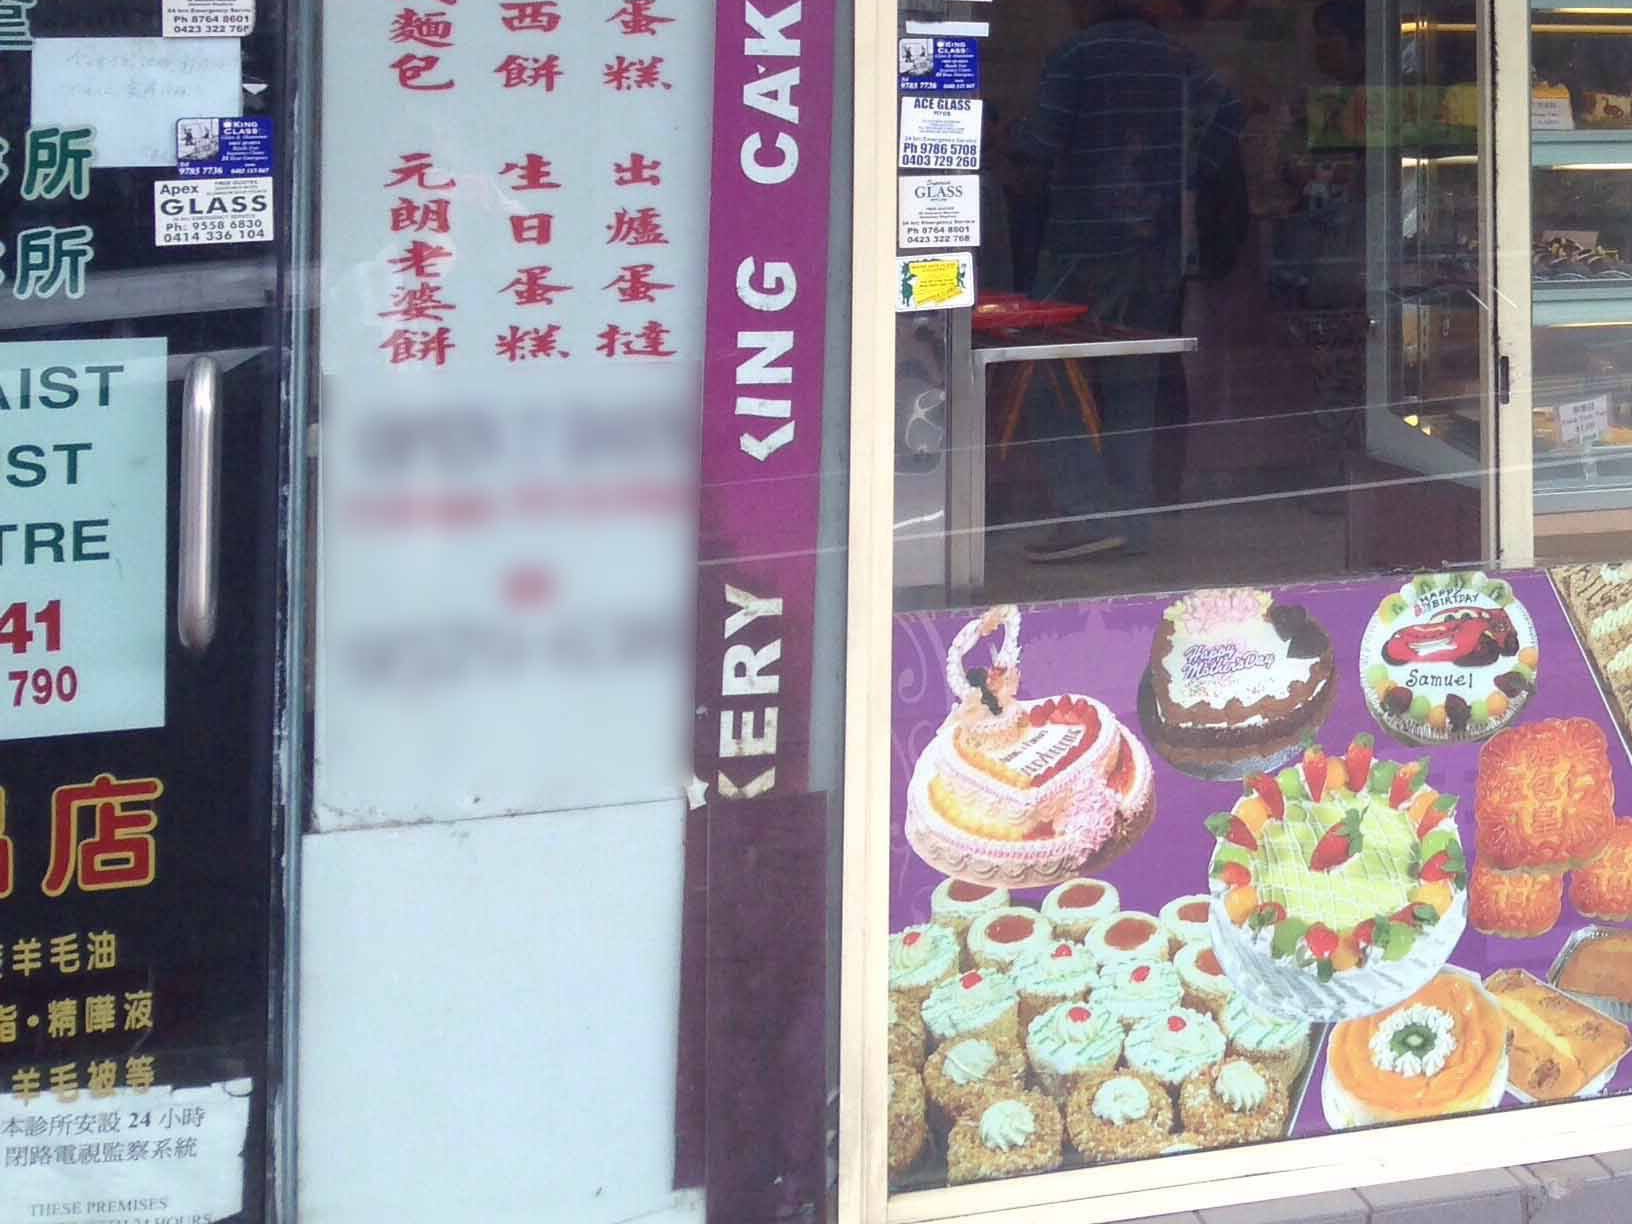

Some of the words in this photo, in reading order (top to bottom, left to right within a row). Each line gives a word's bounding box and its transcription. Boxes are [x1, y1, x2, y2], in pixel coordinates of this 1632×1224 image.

[174, 25, 202, 33] 0423
[914, 98, 934, 110] ACE
[937, 99, 971, 111] GLASS
[904, 143, 917, 153] Ph
[920, 143, 948, 155] 9786
[951, 144, 977, 156] 5708
[0, 128, 97, 201] 所
[902, 154, 931, 167] 0403
[934, 156, 954, 168] 729
[956, 157, 977, 168] 260
[160, 184, 199, 196] Apex
[914, 185, 963, 199] GLASS
[160, 195, 267, 215] GLASS
[193, 221, 225, 231] 9558
[230, 219, 263, 229] 6830
[164, 231, 200, 244] 0414
[206, 230, 233, 242] 336
[240, 228, 265, 240] 104
[0, 225, 95, 301] 所
[378, 152, 456, 367] 元朗老婆餅
[496, 153, 574, 361] 生日蛋糕
[596, 153, 678, 359] 出爐蛋撻
[0, 364, 124, 411] IST
[12, 665, 78, 707] 790
[1406, 668, 1473, 689] Samuel
[0, 773, 164, 898] 店
[0, 930, 118, 977] 羊毛油
[128, 1111, 151, 1128] 24
[160, 1106, 207, 1129] 小時
[87, 1195, 170, 1214] PREMISES
